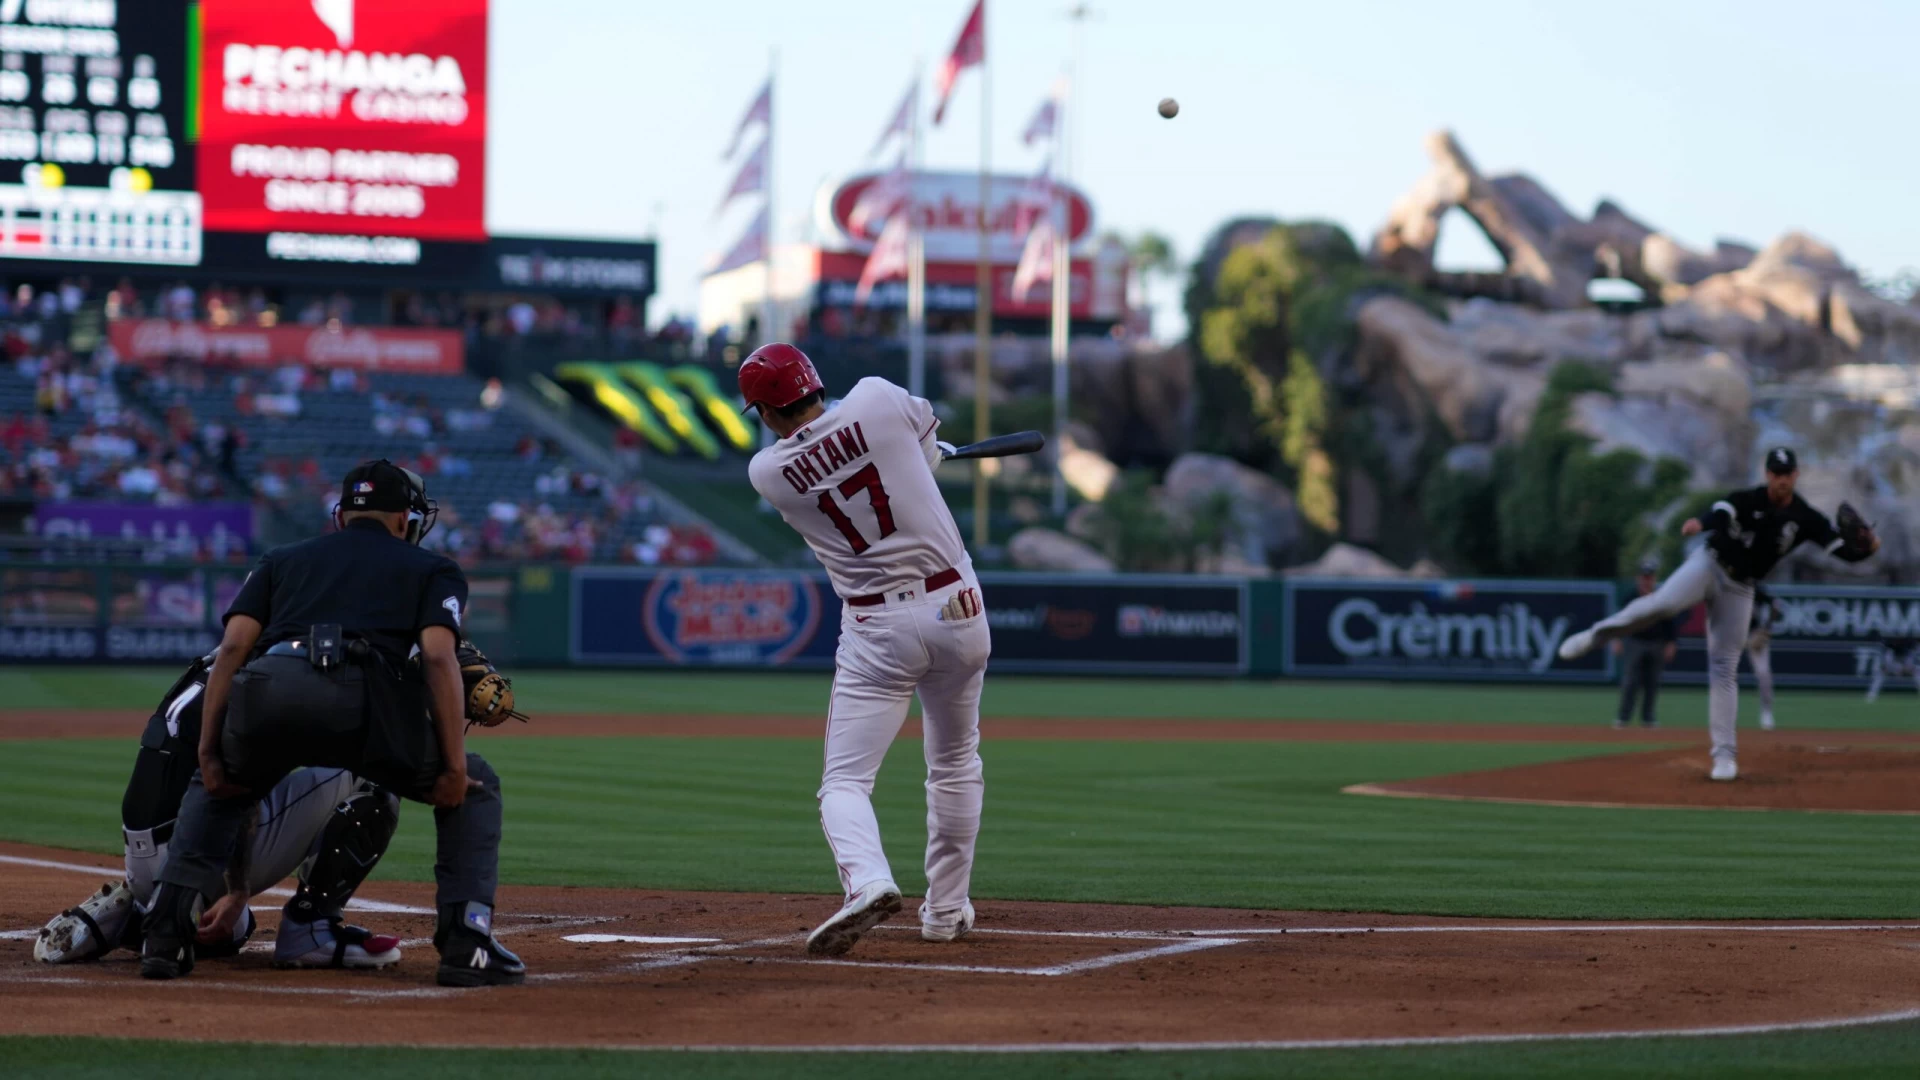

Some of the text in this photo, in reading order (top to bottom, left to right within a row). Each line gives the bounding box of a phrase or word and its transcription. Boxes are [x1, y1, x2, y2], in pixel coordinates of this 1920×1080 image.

[224, 44, 466, 94] PECHANGA
[231, 144, 459, 187] PROUD PARTNER
[264, 179, 349, 214] SINCE
[266, 231, 421, 264] PECHANGA.COM
[794, 375, 803, 386] 17
[782, 421, 870, 495] OHTANI
[817, 462, 898, 556] 17
[1328, 598, 1570, 675] Crèmily
